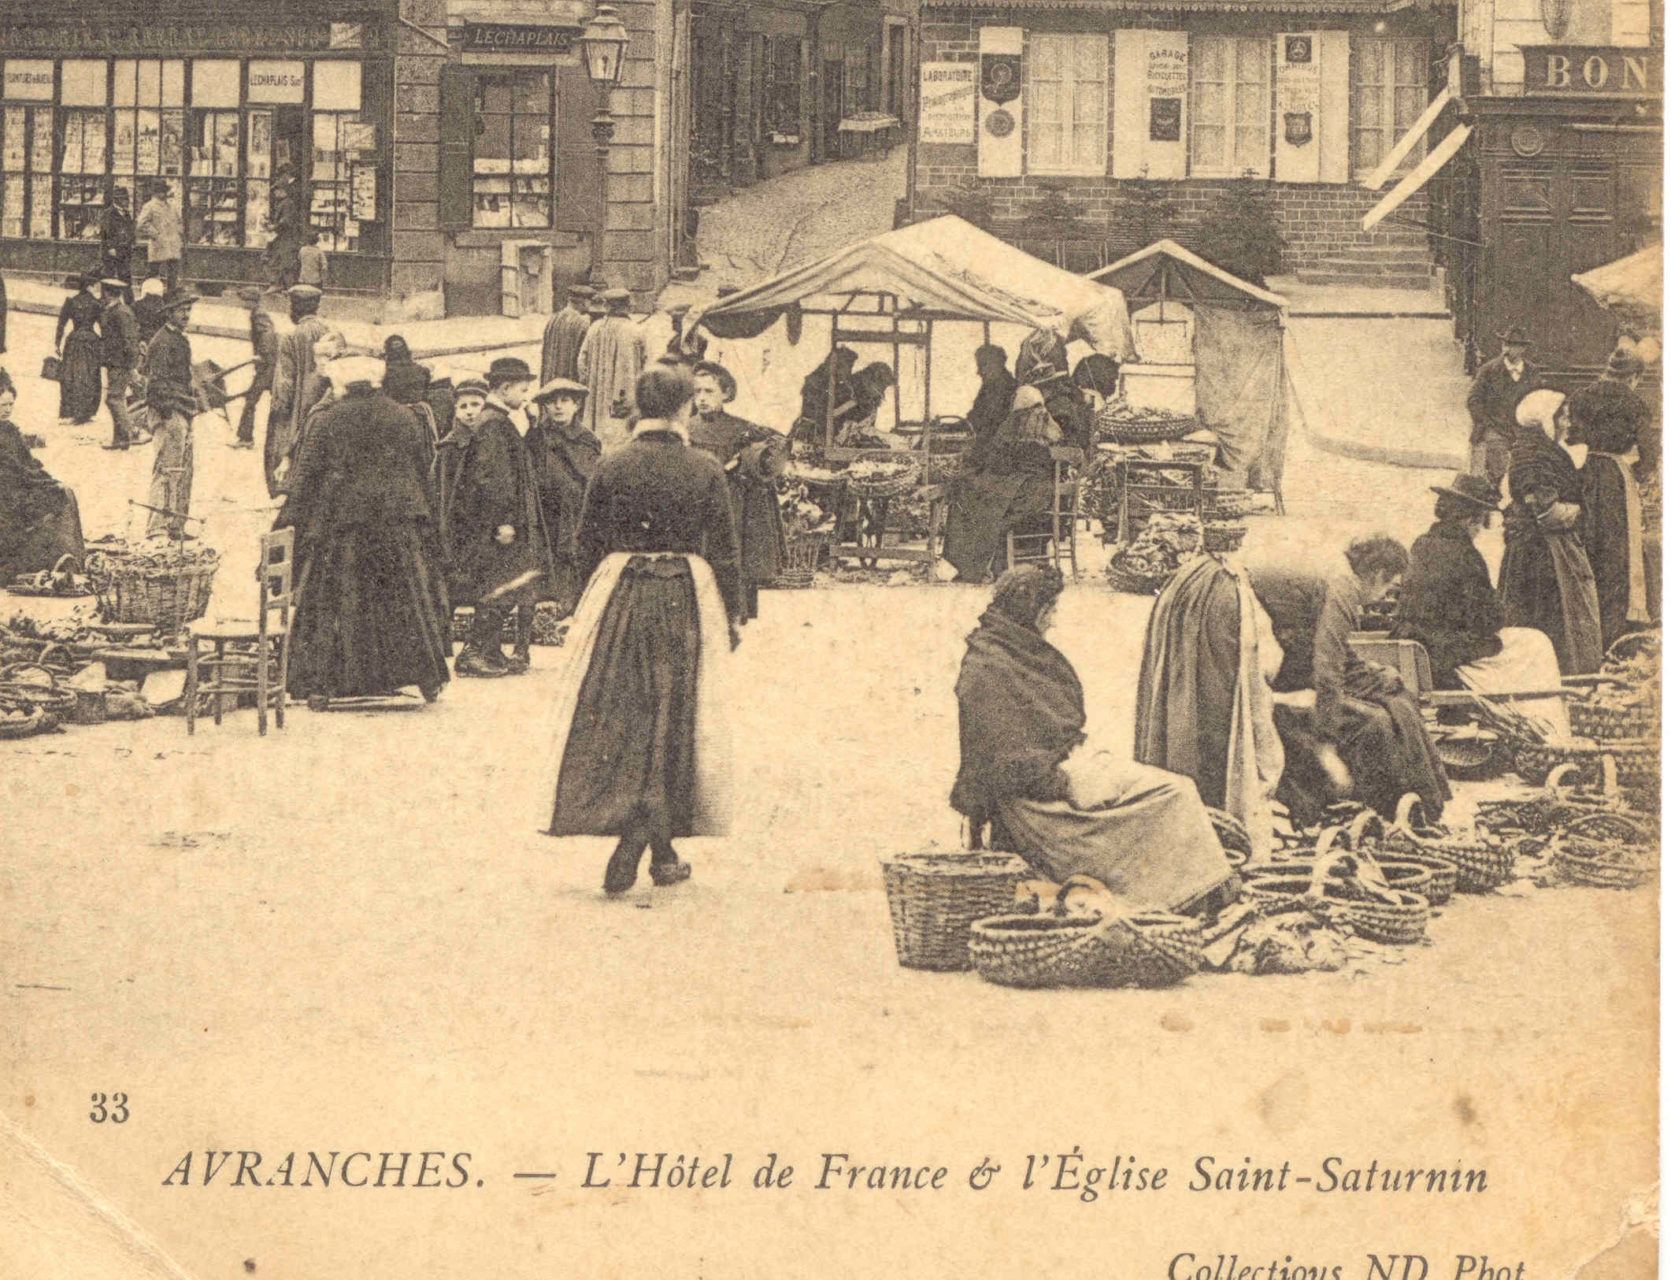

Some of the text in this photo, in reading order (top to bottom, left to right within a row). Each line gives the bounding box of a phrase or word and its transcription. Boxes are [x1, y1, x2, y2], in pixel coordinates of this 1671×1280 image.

[474, 28, 569, 46] LECHAPLAIS
[1149, 49, 1186, 62] GARAGE
[1546, 54, 1650, 89] BON
